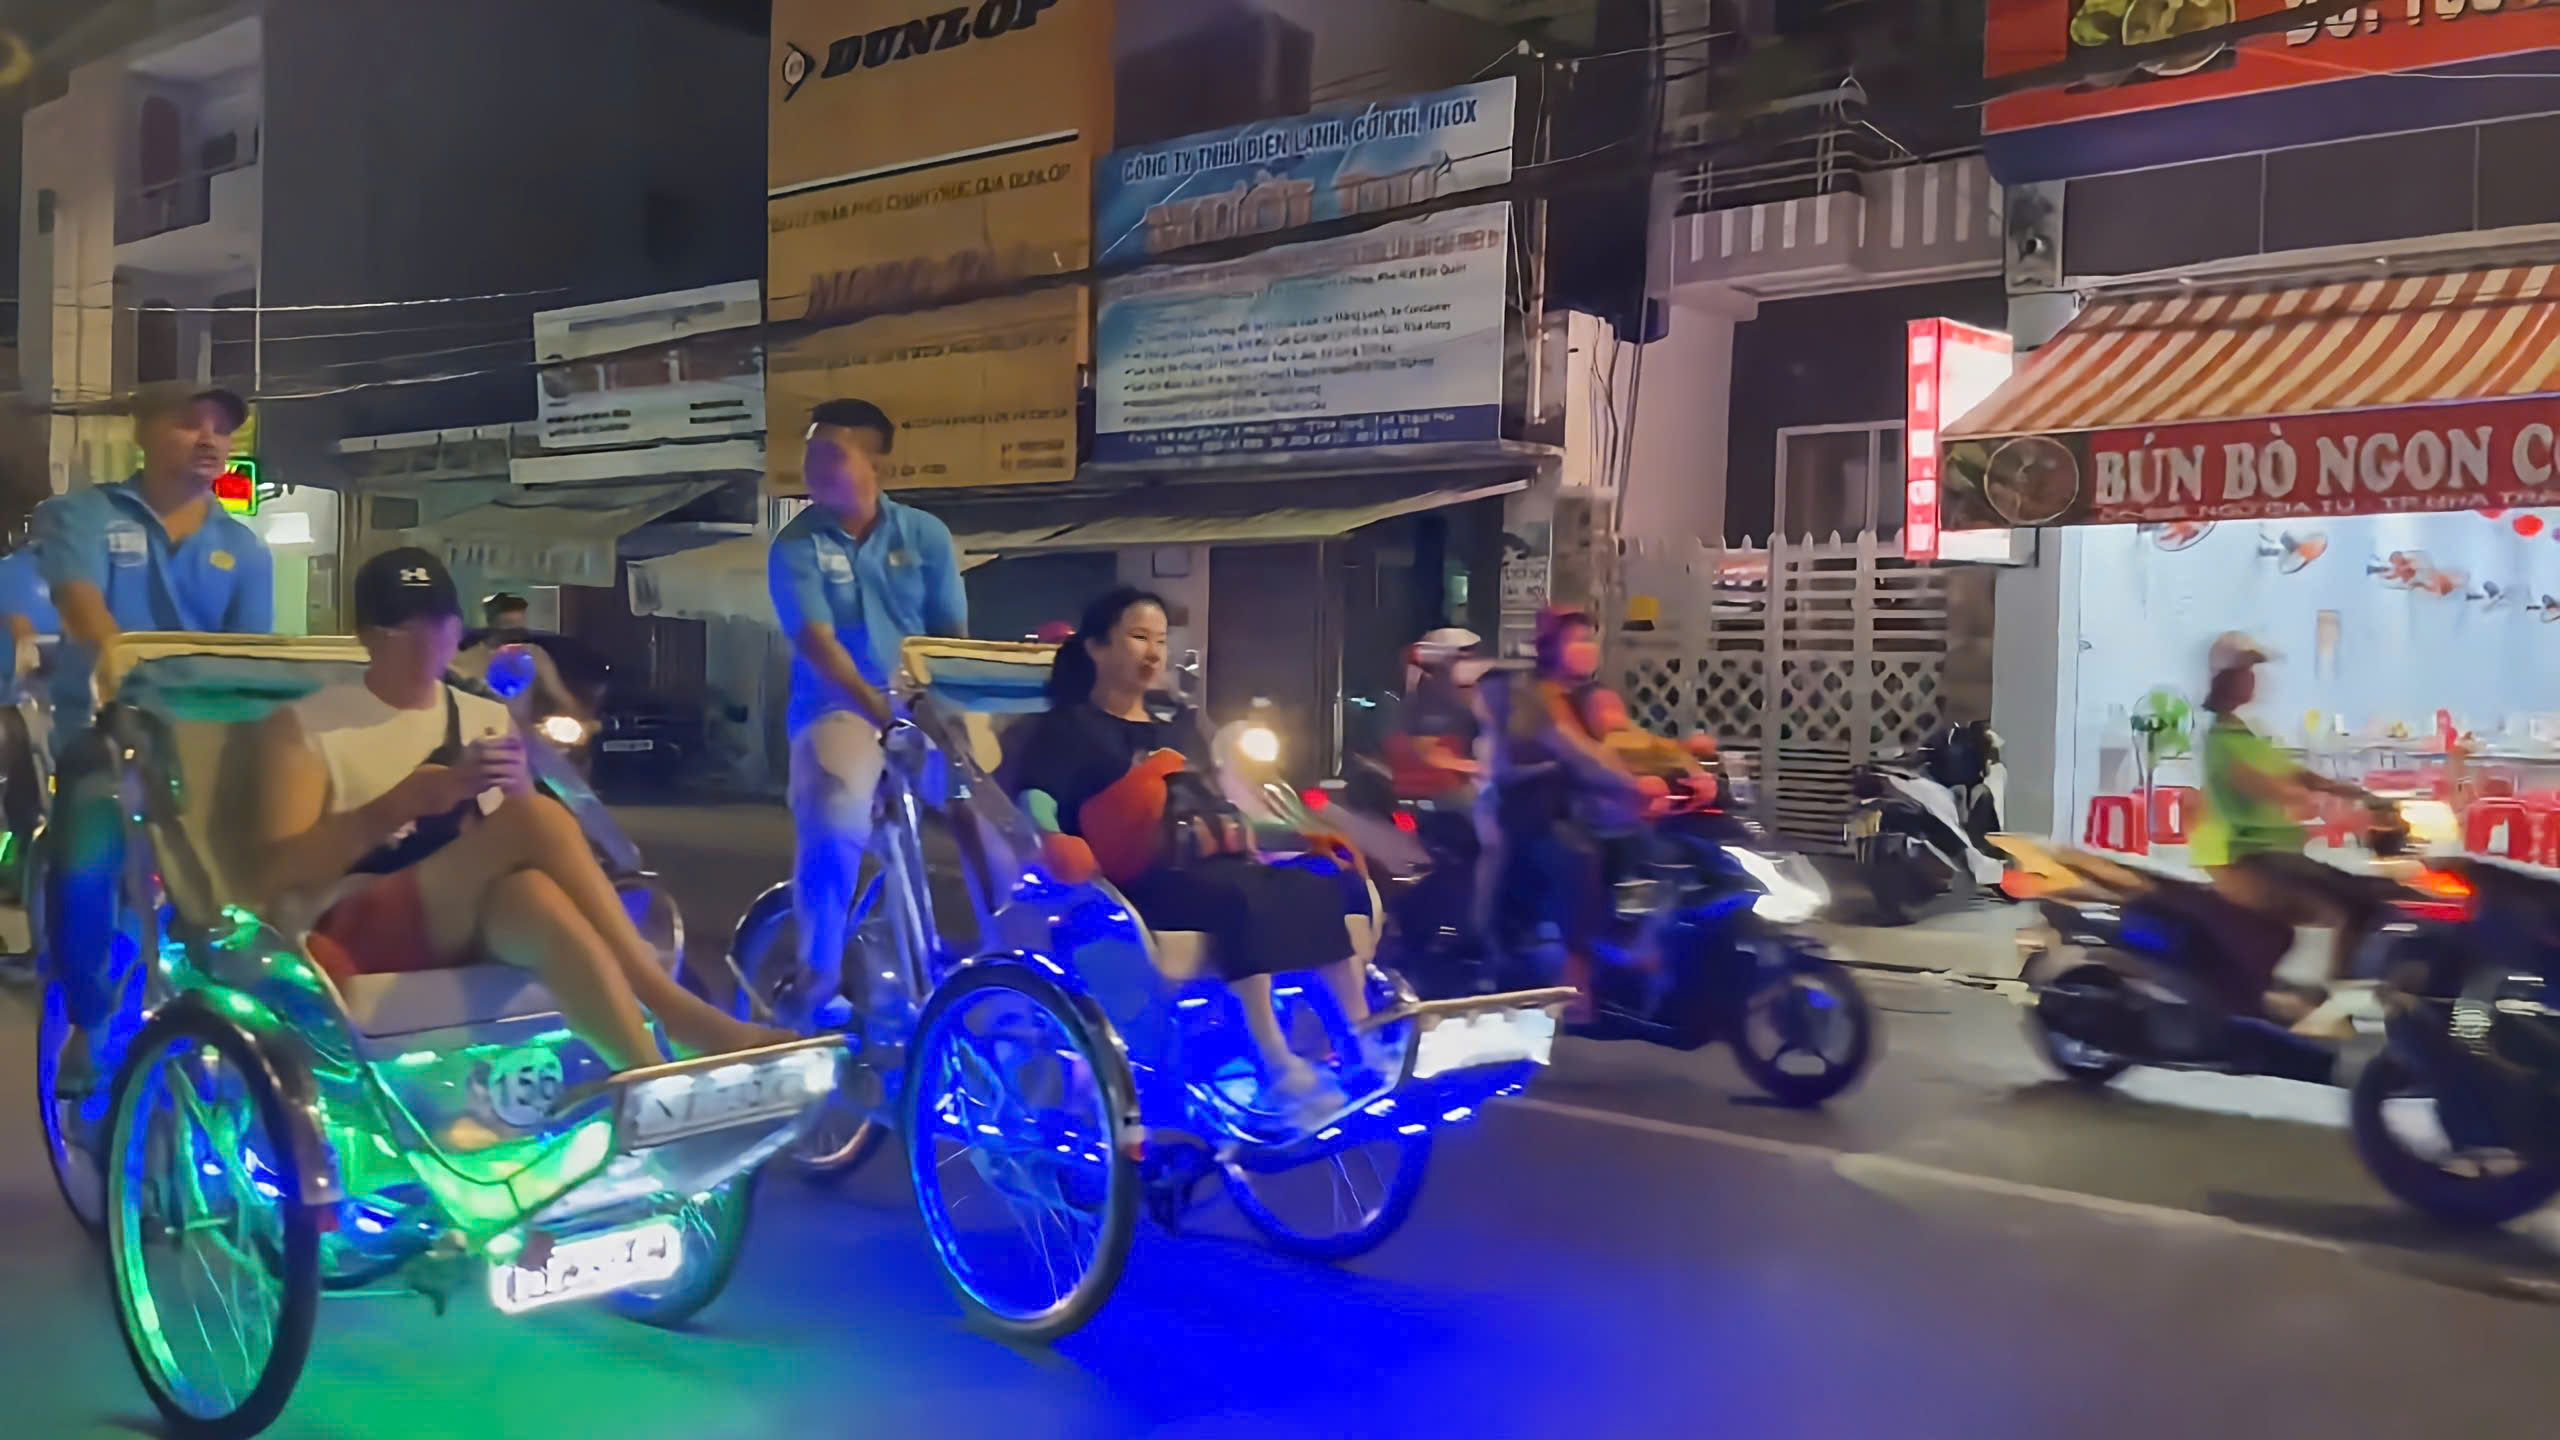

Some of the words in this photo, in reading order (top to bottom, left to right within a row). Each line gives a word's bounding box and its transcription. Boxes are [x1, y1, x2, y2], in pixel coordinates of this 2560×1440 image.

[821, 0, 1058, 78] DUNLOP
[1175, 150, 1191, 175] TY
[1430, 98, 1477, 130] INOX
[2096, 431, 2206, 504] BÚN
[2223, 422, 2297, 498] BÒ
[2315, 425, 2493, 495] NGON
[2512, 423, 2560, 486] C
